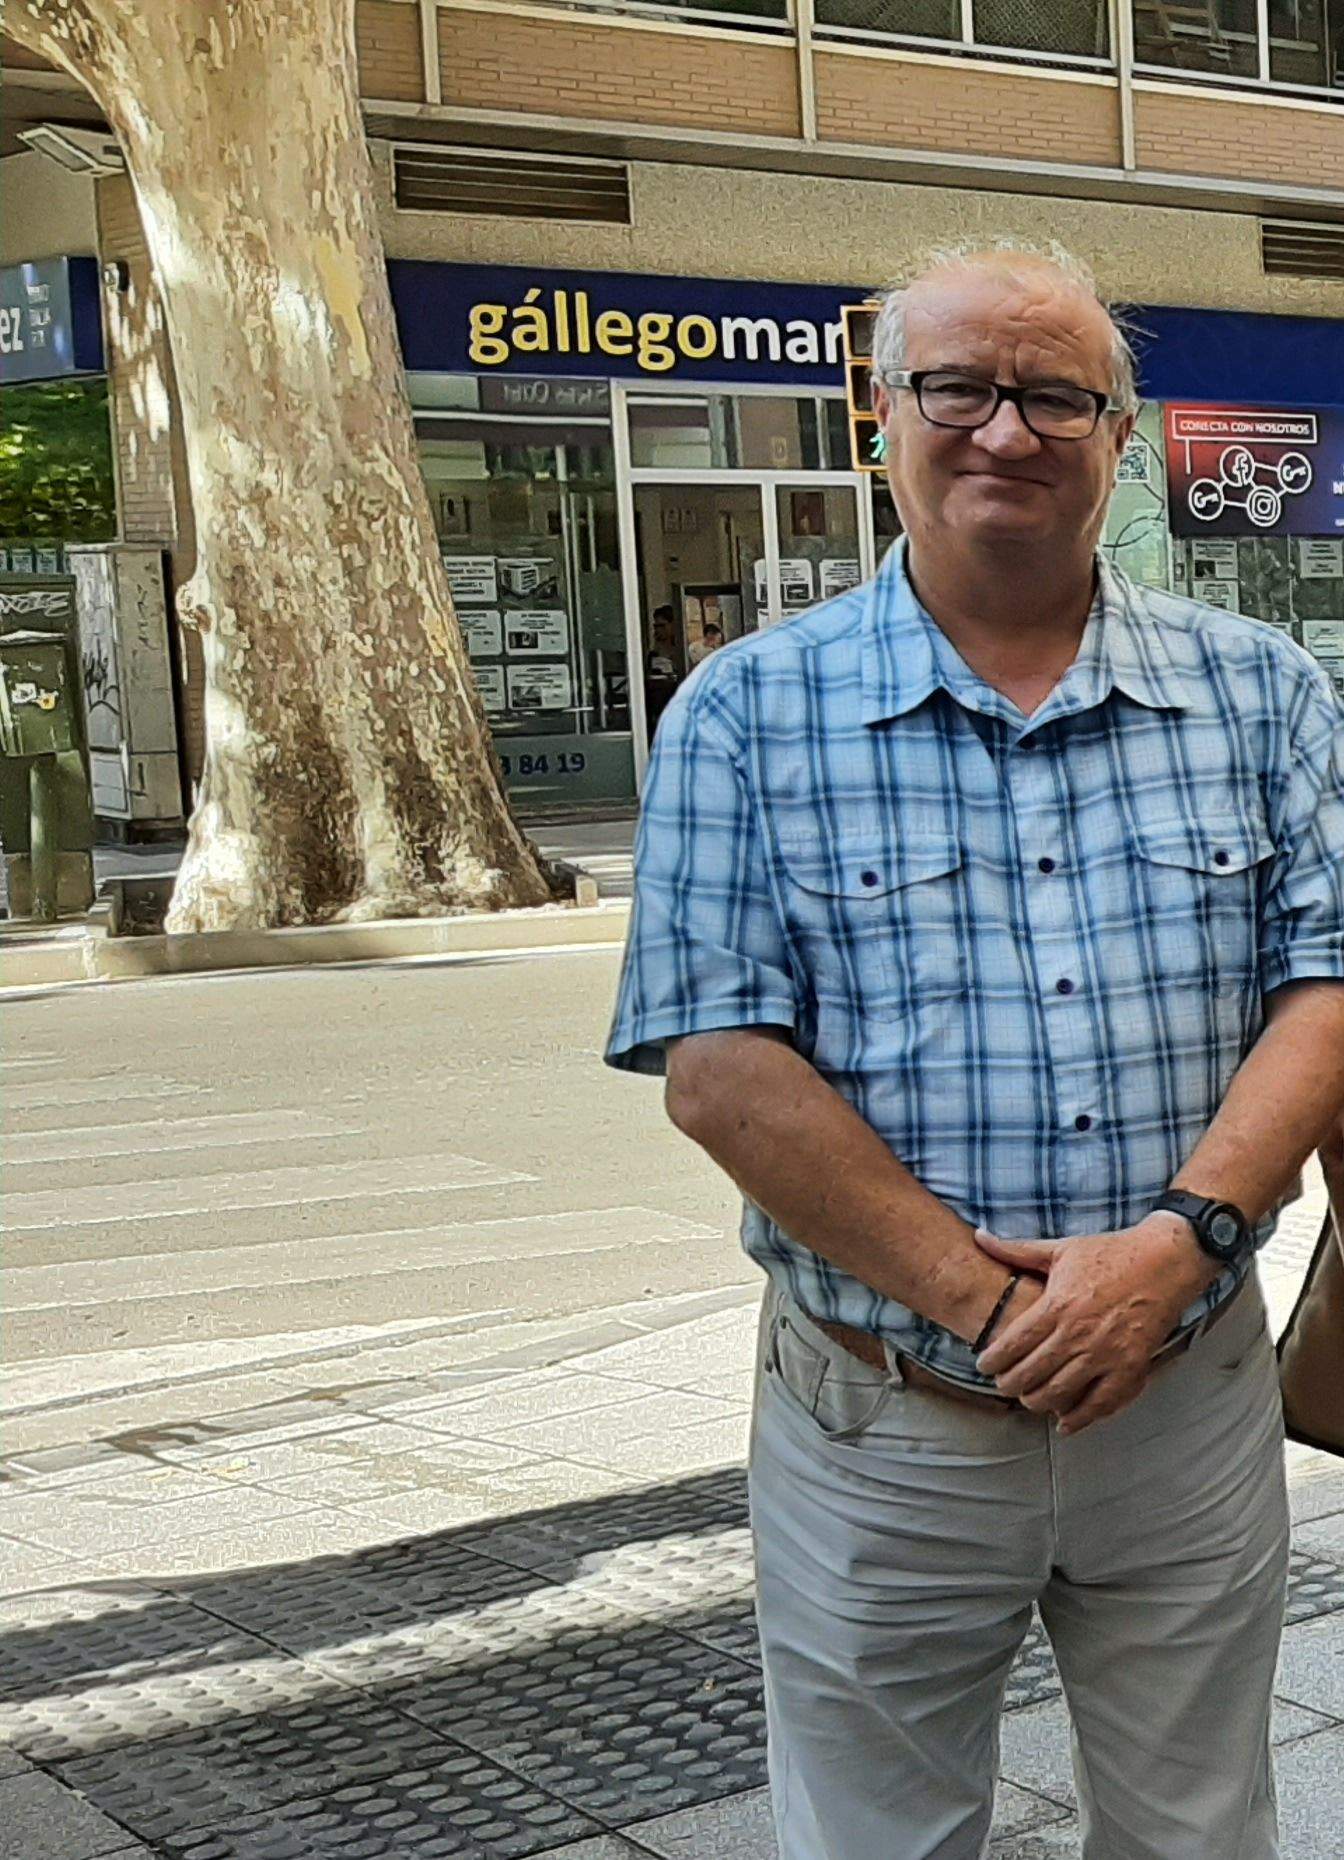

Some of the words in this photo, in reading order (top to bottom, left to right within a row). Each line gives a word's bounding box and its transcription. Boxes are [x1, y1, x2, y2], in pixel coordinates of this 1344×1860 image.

[1231, 421, 1253, 433] CON
[1255, 422, 1310, 435] NOSOTROS
[519, 754, 549, 776] 84
[557, 752, 586, 774] 19
